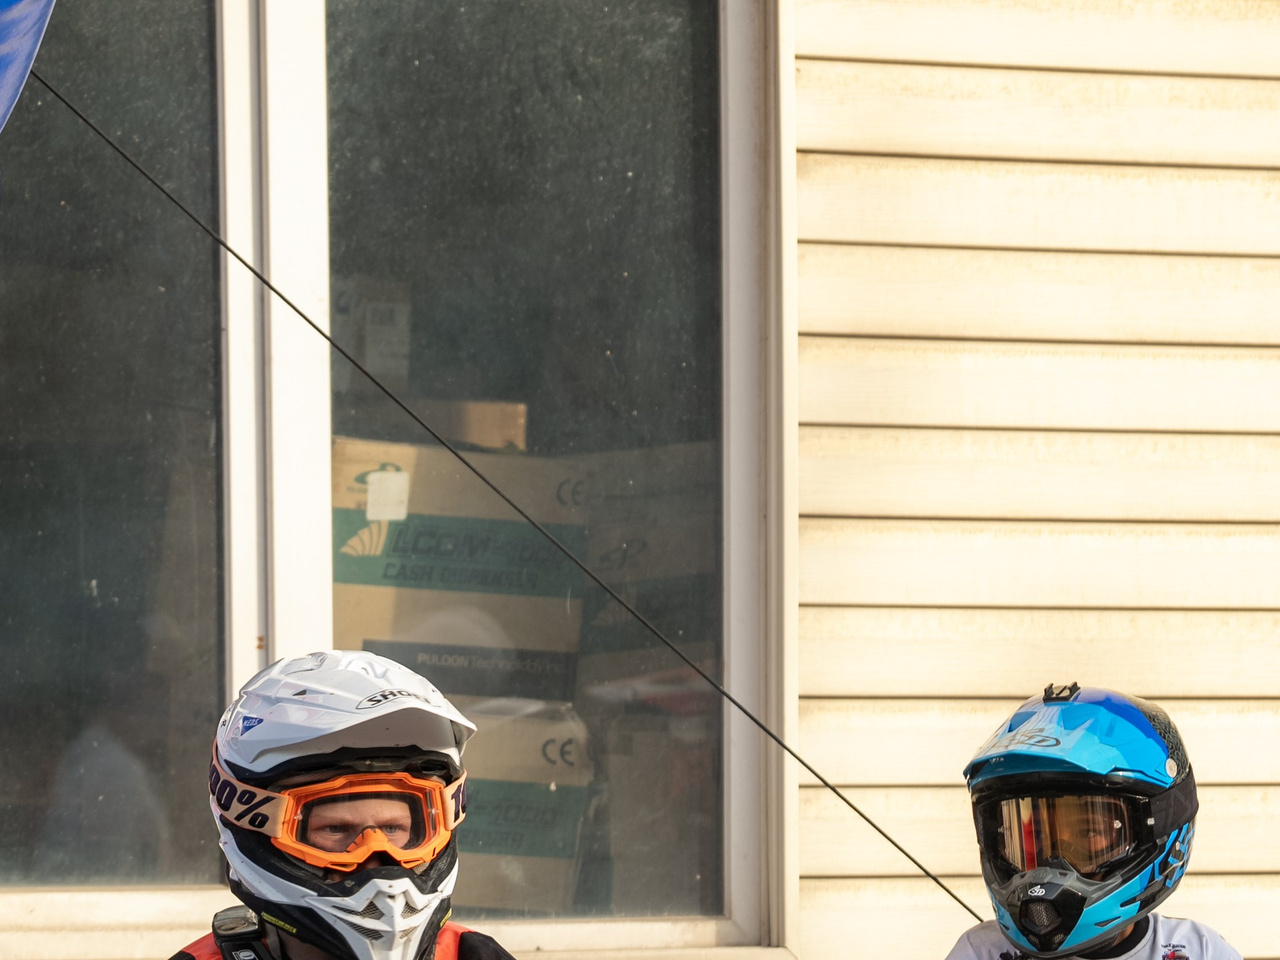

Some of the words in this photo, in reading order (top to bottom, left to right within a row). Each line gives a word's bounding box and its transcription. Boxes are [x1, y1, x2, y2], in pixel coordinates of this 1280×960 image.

[383, 562, 434, 582] CASH
[417, 653, 469, 667] PULOON
[542, 738, 575, 766] CE
